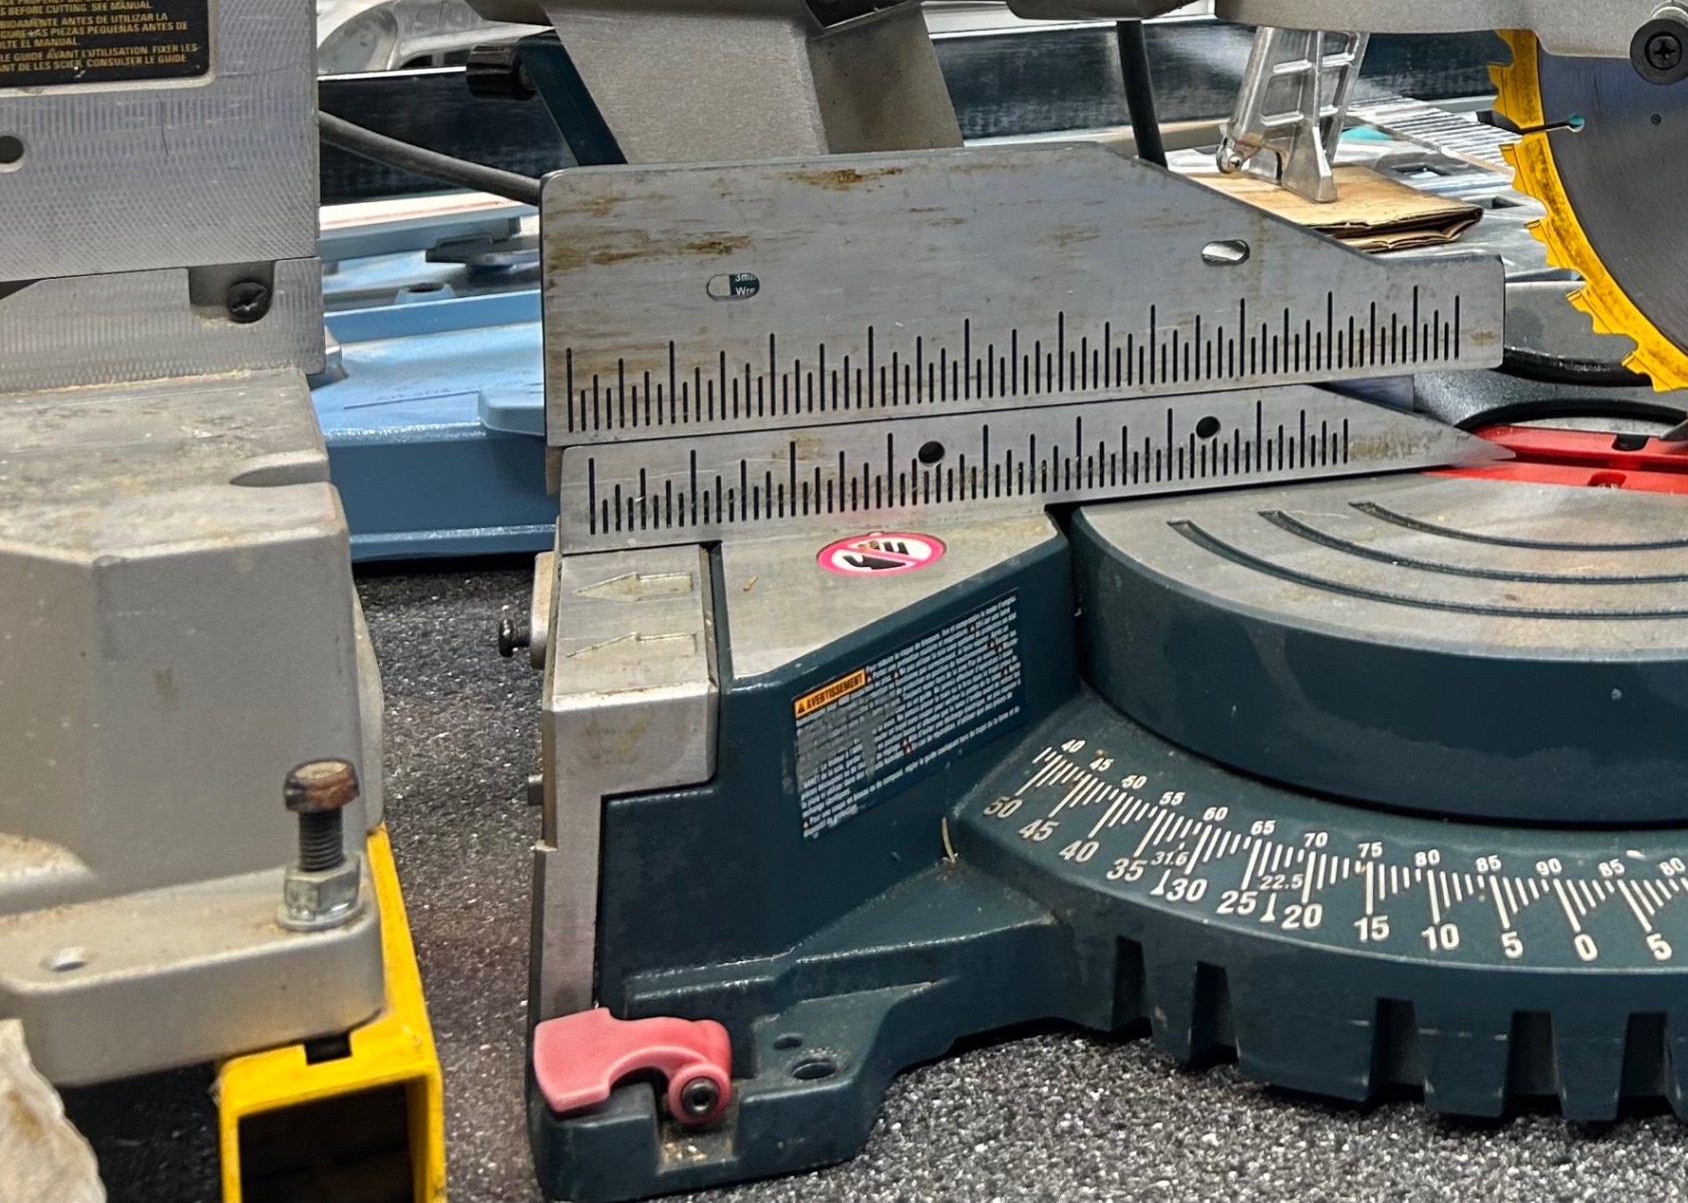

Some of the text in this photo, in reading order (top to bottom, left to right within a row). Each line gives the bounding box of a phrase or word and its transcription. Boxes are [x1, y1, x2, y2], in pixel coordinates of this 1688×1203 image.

[8, 5, 44, 15] BEFORE
[92, 2, 109, 12] SEE
[61, 16, 94, 26] ANTES
[96, 15, 109, 24] DE
[111, 13, 154, 24] UTILIZAR
[156, 12, 168, 21] LA
[50, 26, 85, 37] PIEZAS
[142, 22, 174, 32] ANTES
[175, 21, 189, 30] DE
[13, 52, 44, 62] GUIDE
[46, 50, 79, 60] AVANT
[152, 44, 179, 54] FIXER
[18, 62, 32, 71] DE
[34, 61, 51, 71] LES
[86, 56, 142, 68] CONSULTER
[145, 55, 156, 64] LE
[158, 54, 187, 63] GUIDE
[806, 672, 865, 709] AVERTISSEMENT
[1061, 739, 1086, 753] 40
[1090, 757, 1114, 772] 45
[1121, 774, 1147, 790] 50
[1159, 791, 1185, 806] 55
[1202, 806, 1229, 821] 60
[1250, 820, 1277, 835] 65
[1304, 831, 1329, 848] 70
[1358, 842, 1383, 858] 75
[1414, 848, 1441, 866] 80
[1475, 854, 1502, 873] 85
[1535, 857, 1563, 877] 90
[1599, 857, 1626, 878] 85
[1659, 857, 1687, 878] 80
[1150, 850, 1189, 867] 31.6
[983, 797, 1025, 819] 50
[1016, 820, 1060, 842] 45
[1058, 839, 1100, 863] 40
[1106, 858, 1148, 882] 35
[1166, 878, 1208, 902] 30
[1216, 890, 1258, 915] 25
[1281, 903, 1323, 929] 20
[1353, 915, 1390, 942] 15
[1421, 923, 1460, 951] 10
[1501, 930, 1523, 959] 5
[1573, 933, 1598, 961] 0
[1647, 933, 1673, 961] 5
[1259, 873, 1303, 891] 22.5
